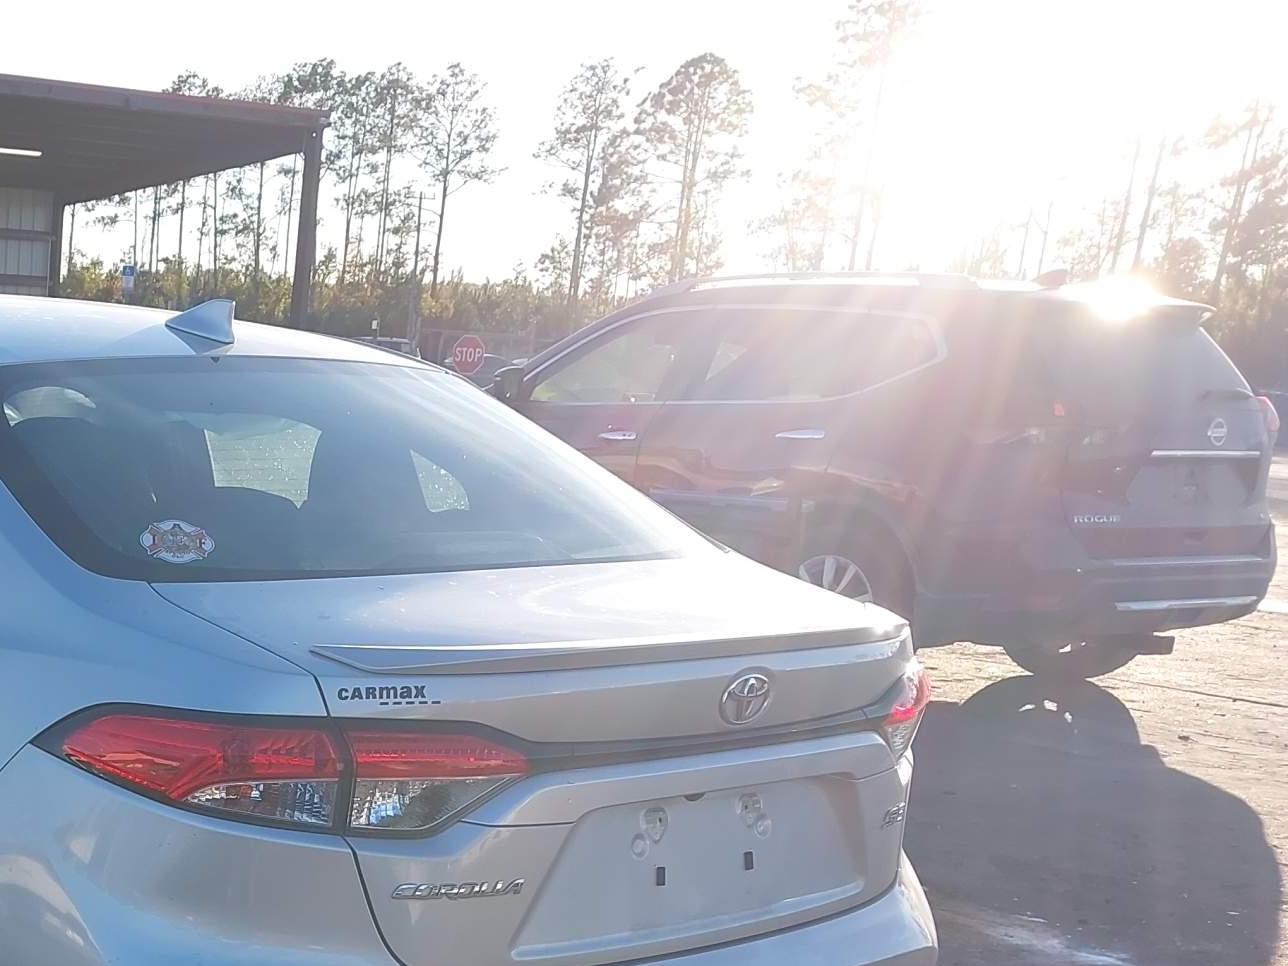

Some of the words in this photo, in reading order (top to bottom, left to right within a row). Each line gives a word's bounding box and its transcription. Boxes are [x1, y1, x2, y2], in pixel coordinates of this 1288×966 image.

[454, 347, 483, 363] STOP
[1073, 514, 1121, 524] ROGUE
[391, 878, 525, 900] COROLLA
